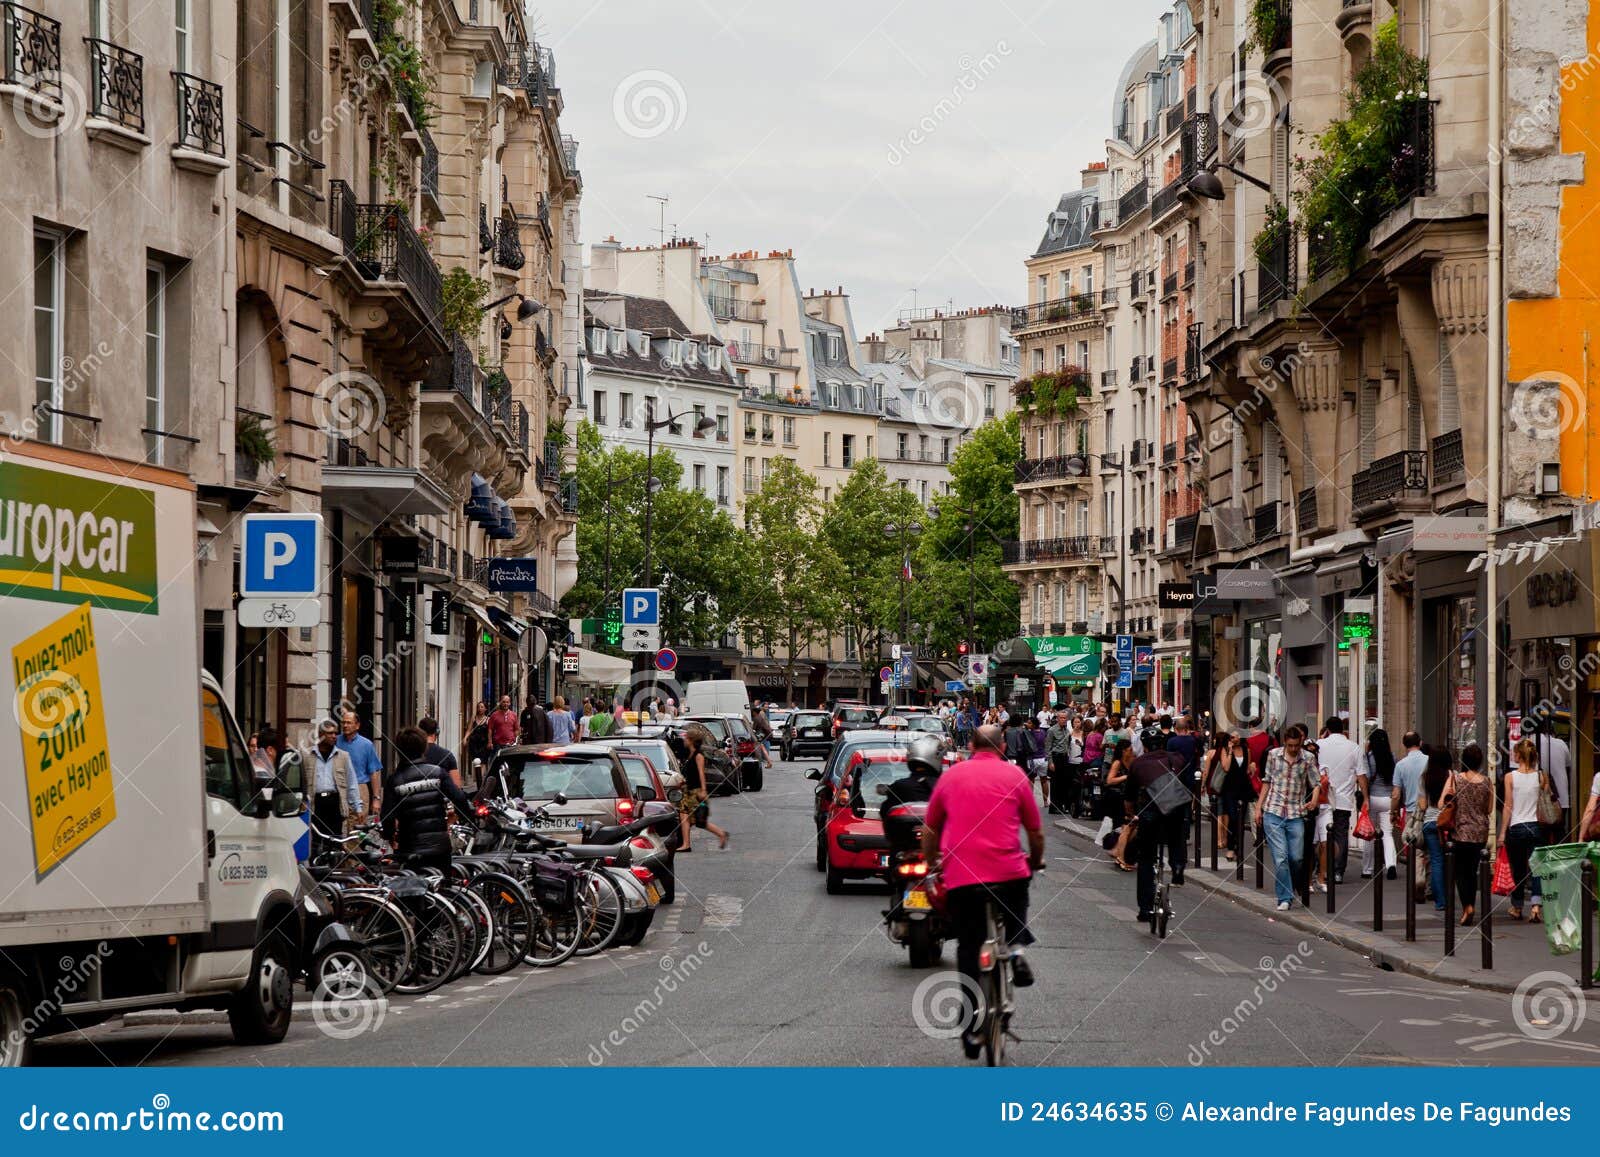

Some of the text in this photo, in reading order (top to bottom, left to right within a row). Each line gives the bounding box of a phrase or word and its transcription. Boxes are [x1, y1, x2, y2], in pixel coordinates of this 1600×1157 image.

[264, 532, 297, 580] P
[633, 596, 649, 618] P
[1120, 638, 1128, 648] P
[760, 676, 797, 688] COSMS
[34, 749, 108, 818] avec Hayon
